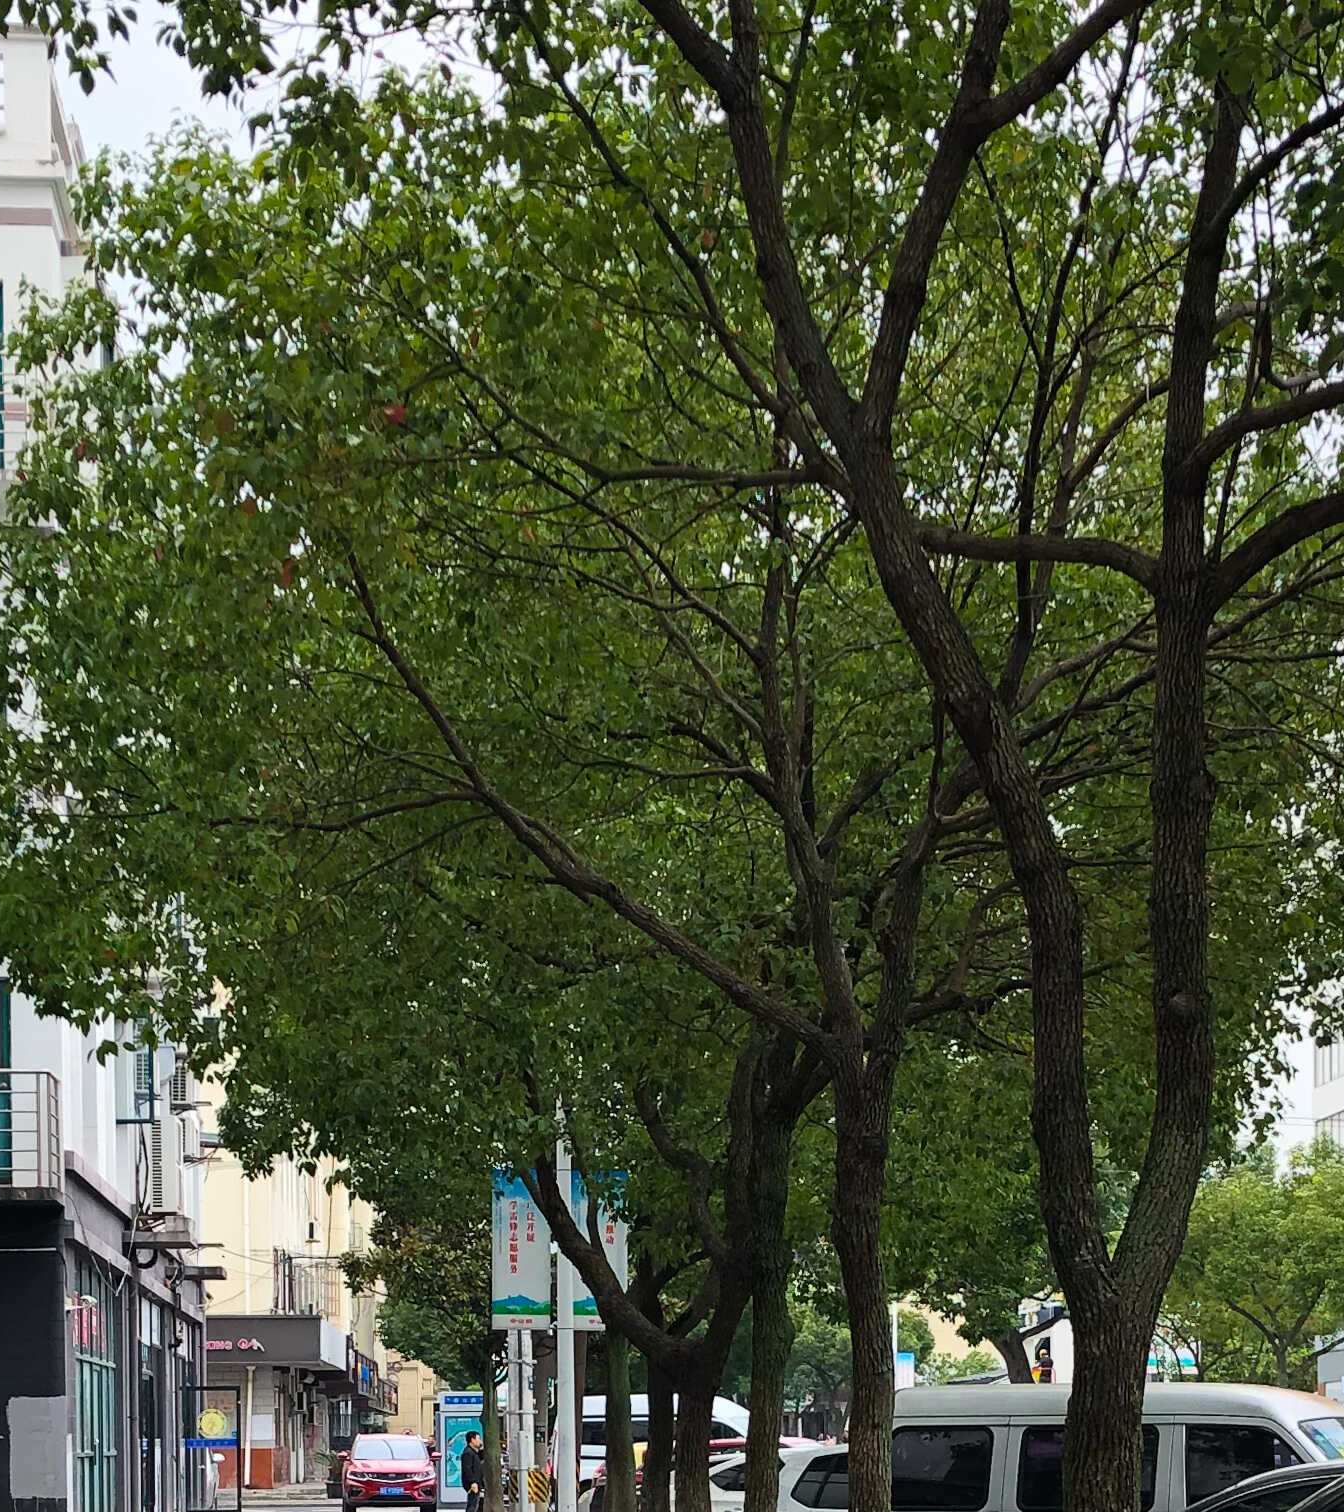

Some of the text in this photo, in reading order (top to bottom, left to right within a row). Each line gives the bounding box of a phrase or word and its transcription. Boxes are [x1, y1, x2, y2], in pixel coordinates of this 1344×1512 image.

[509, 1201, 518, 1274] 学雷锋志愿服务
